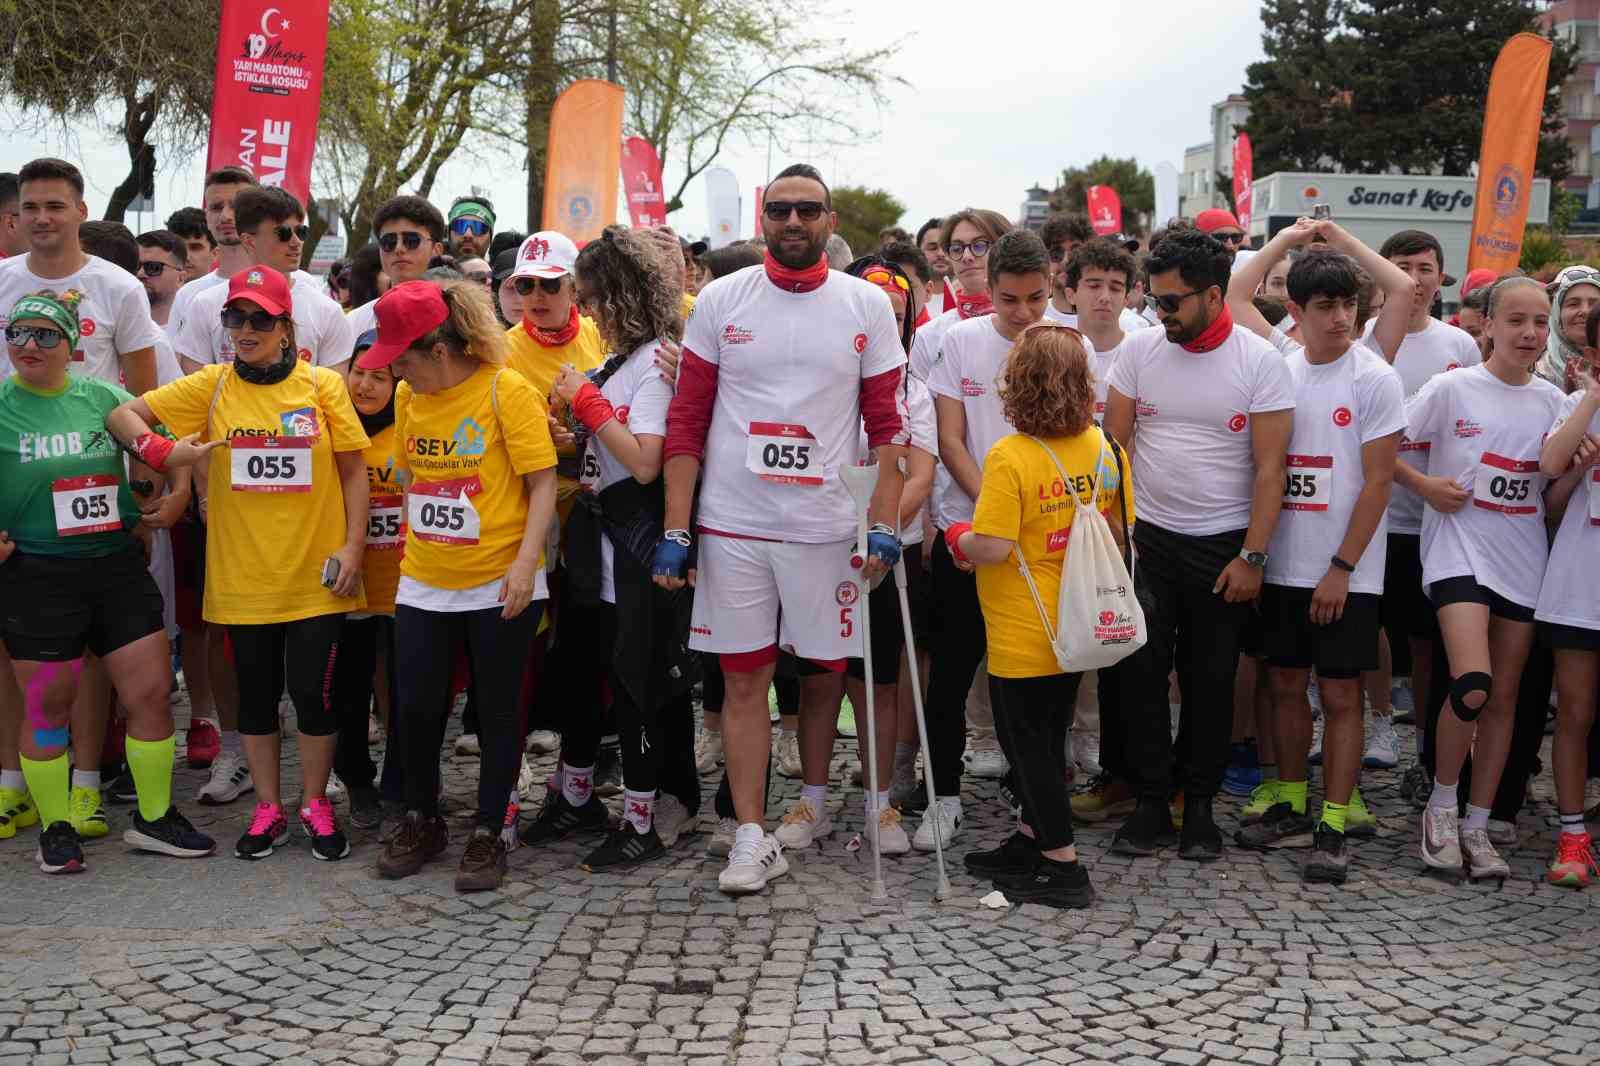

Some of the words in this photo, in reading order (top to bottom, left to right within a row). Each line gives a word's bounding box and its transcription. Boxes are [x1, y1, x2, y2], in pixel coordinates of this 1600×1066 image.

[253, 62, 303, 78] MARATONU
[1348, 186, 1418, 206] Sanat
[1421, 188, 1473, 212] Kafe
[247, 455, 296, 479] 055
[762, 443, 810, 470] 055
[1038, 473, 1099, 501] LÖSEV
[1489, 476, 1531, 501] 055
[71, 494, 110, 520] 055
[420, 502, 465, 531] 055
[366, 514, 400, 537] 55
[840, 608, 853, 638] 5
